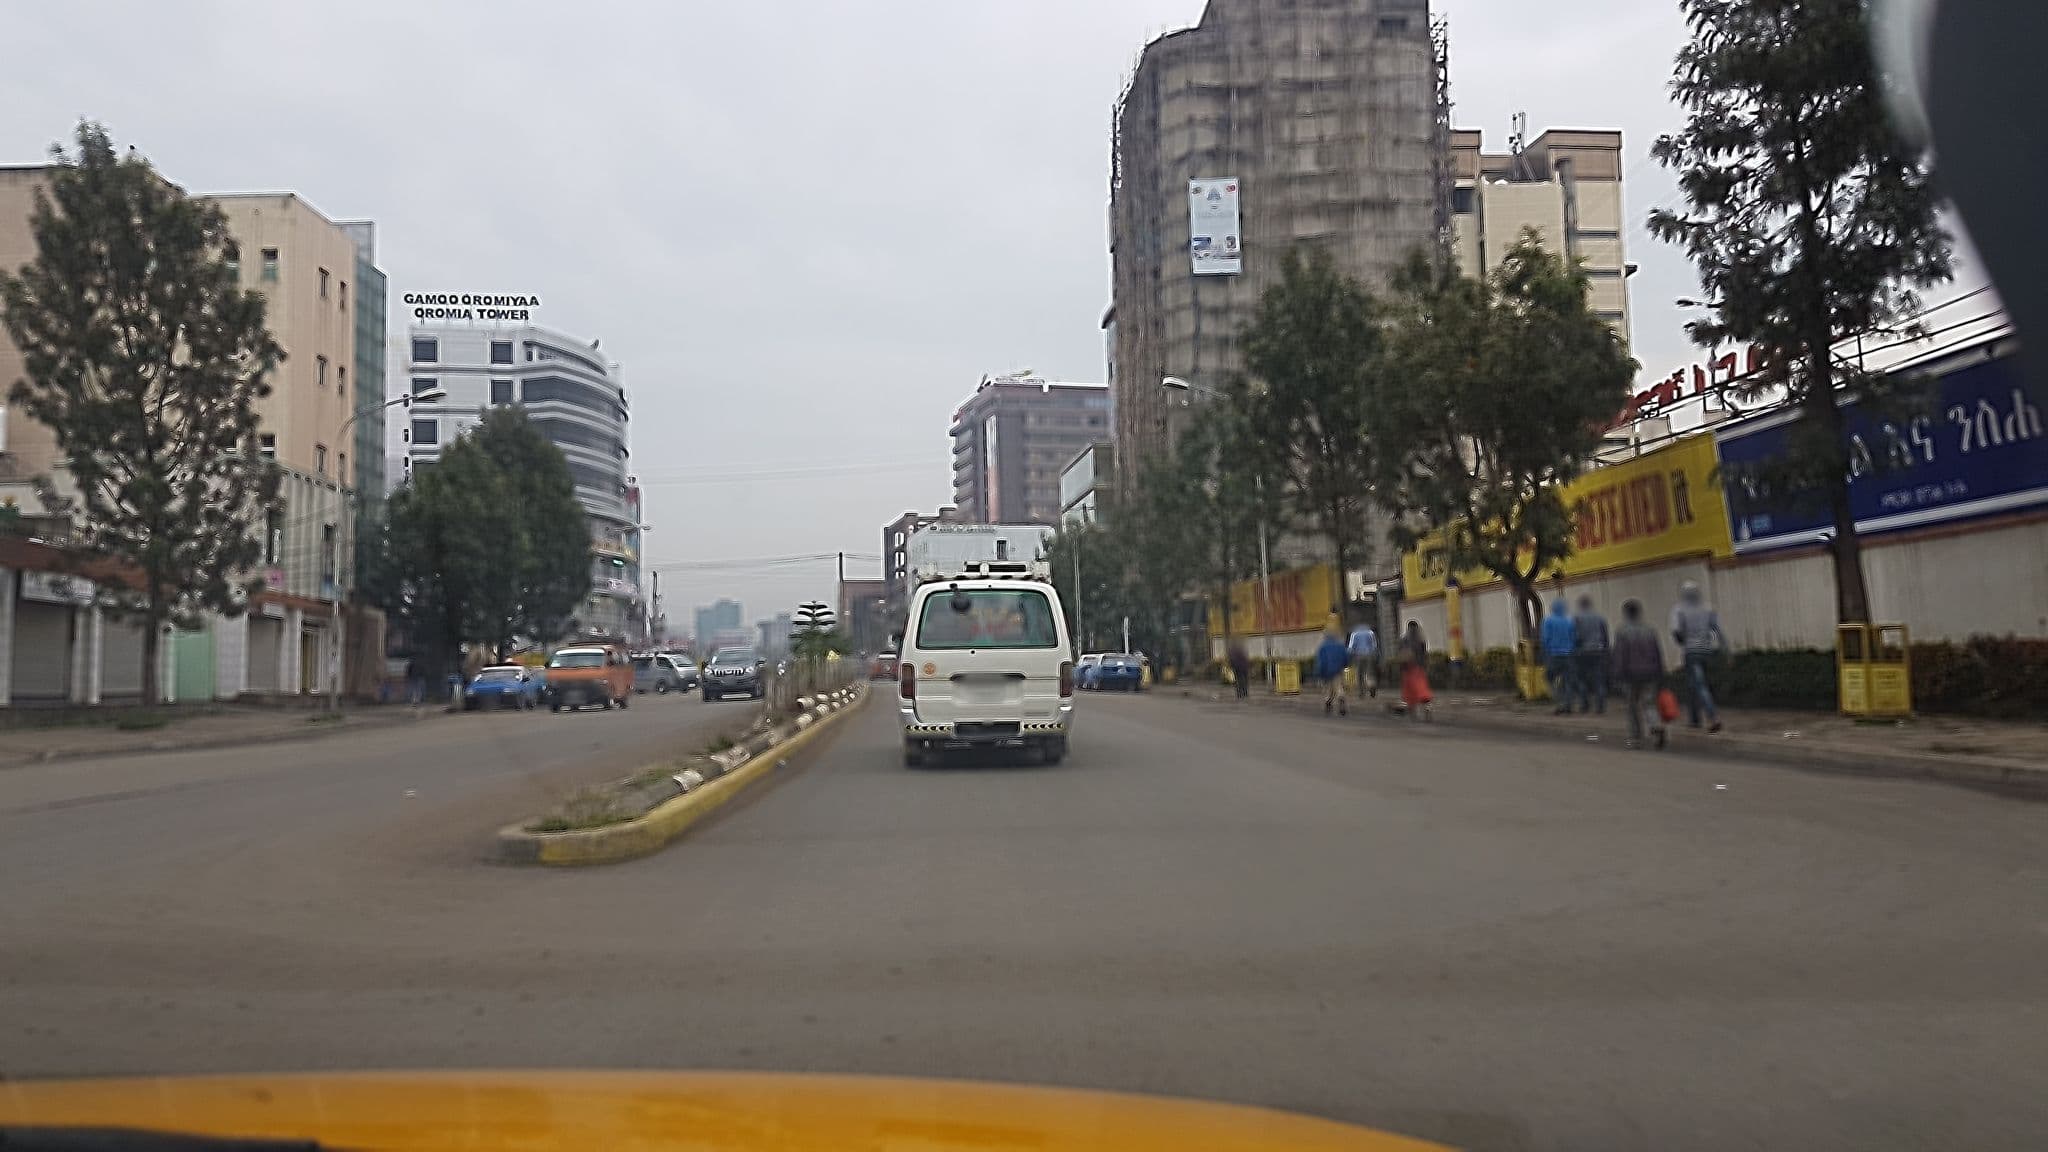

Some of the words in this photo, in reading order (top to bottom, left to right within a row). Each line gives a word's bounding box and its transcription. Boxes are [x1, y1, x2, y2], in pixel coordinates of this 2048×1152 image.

[404, 293, 459, 305] GAMOO
[461, 294, 540, 306] OROMIYAA
[414, 308, 473, 320] OROMIA
[477, 308, 530, 321] TOWER
